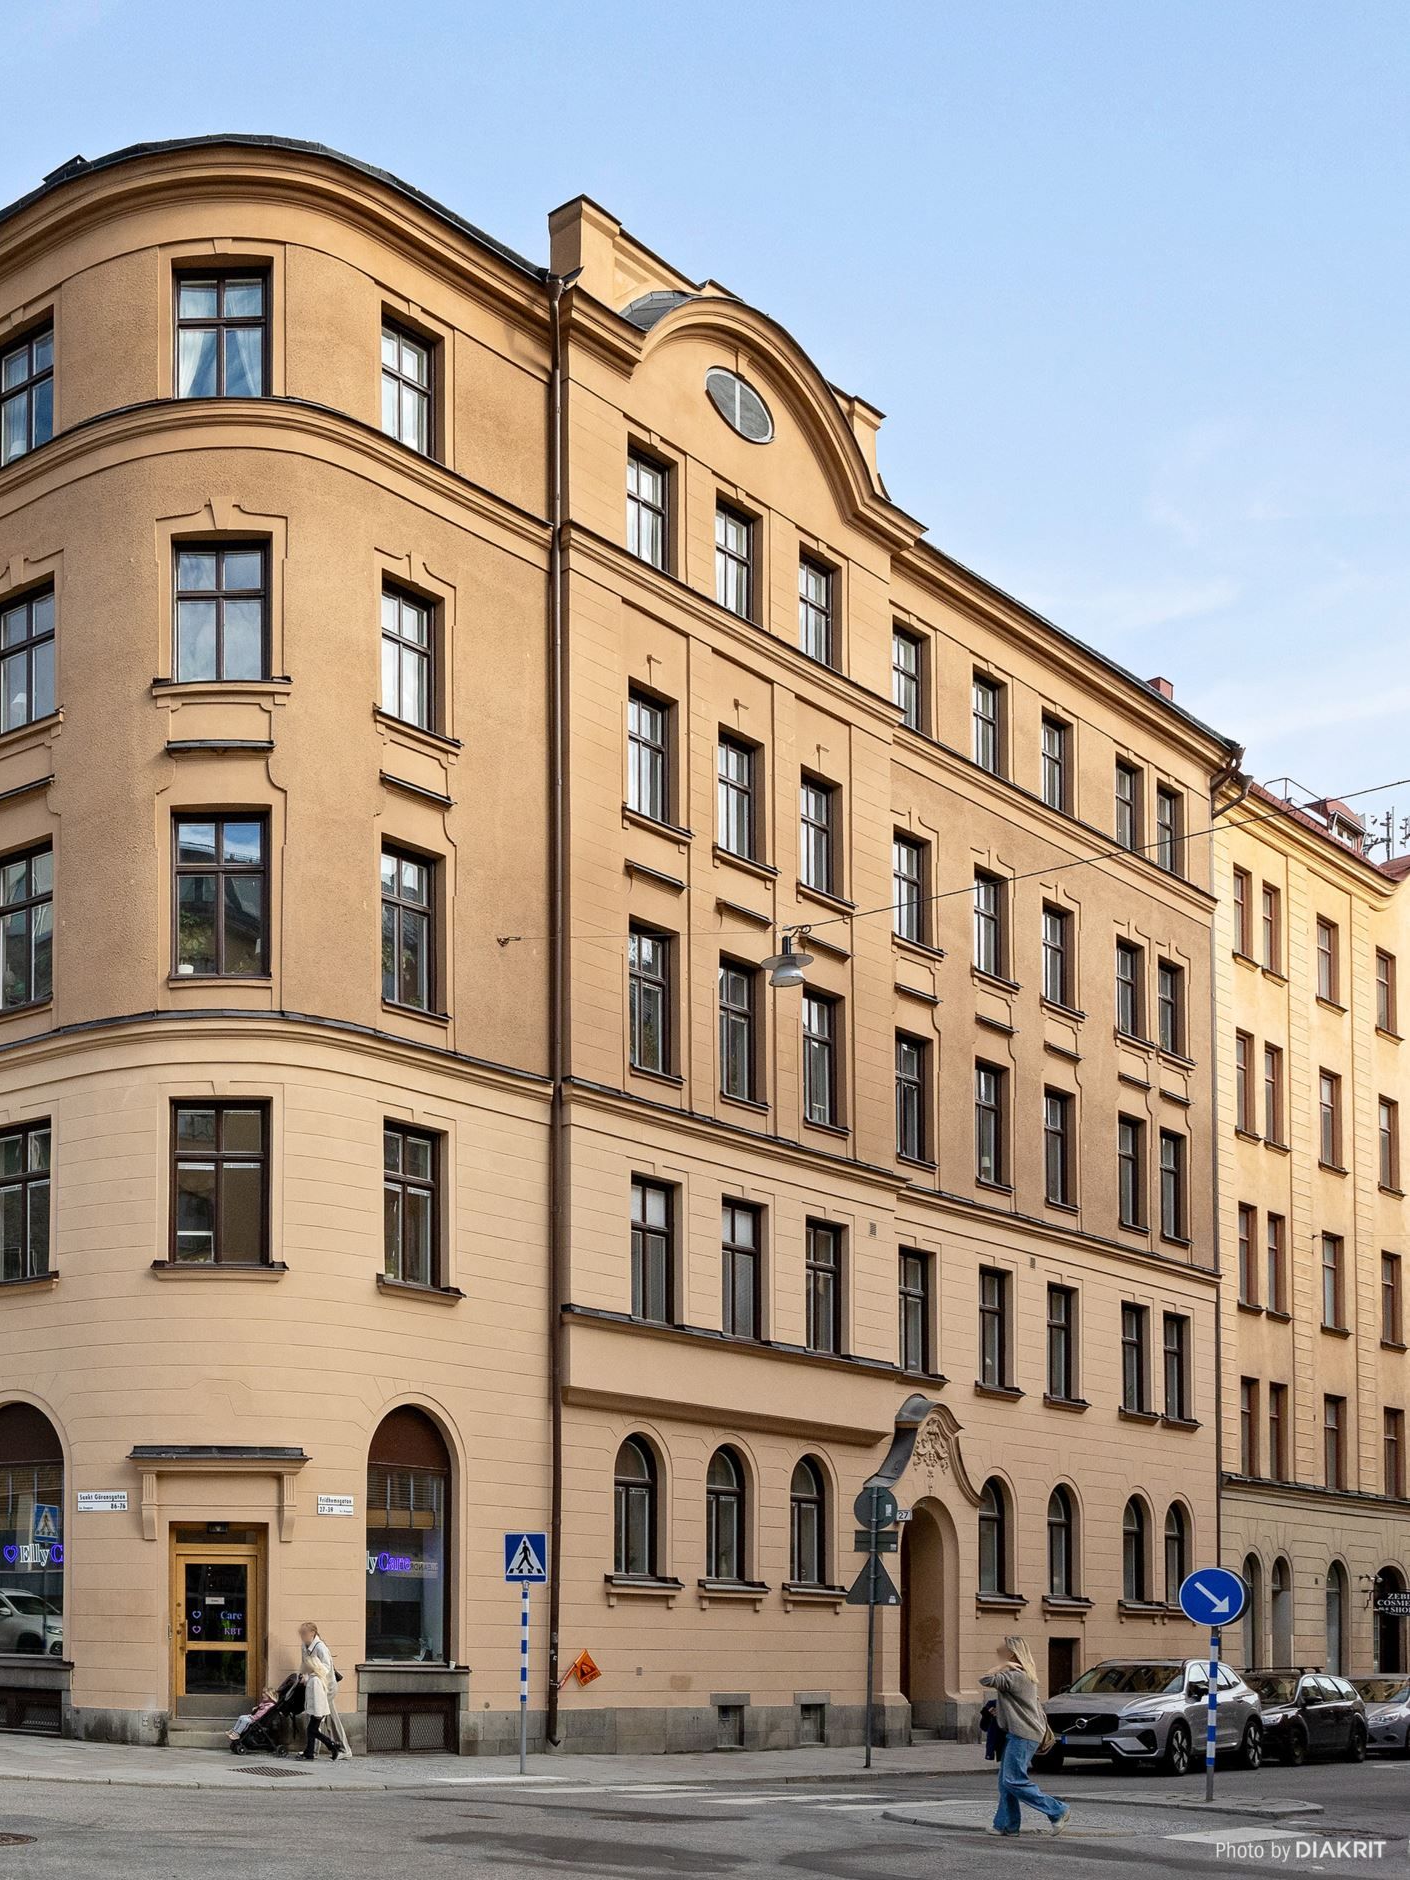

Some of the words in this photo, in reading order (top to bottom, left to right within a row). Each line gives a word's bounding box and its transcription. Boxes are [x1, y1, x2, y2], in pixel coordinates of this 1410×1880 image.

[94, 1494, 126, 1502] Göransgatan
[220, 1611, 243, 1620] Care
[224, 1627, 242, 1635] KBT
